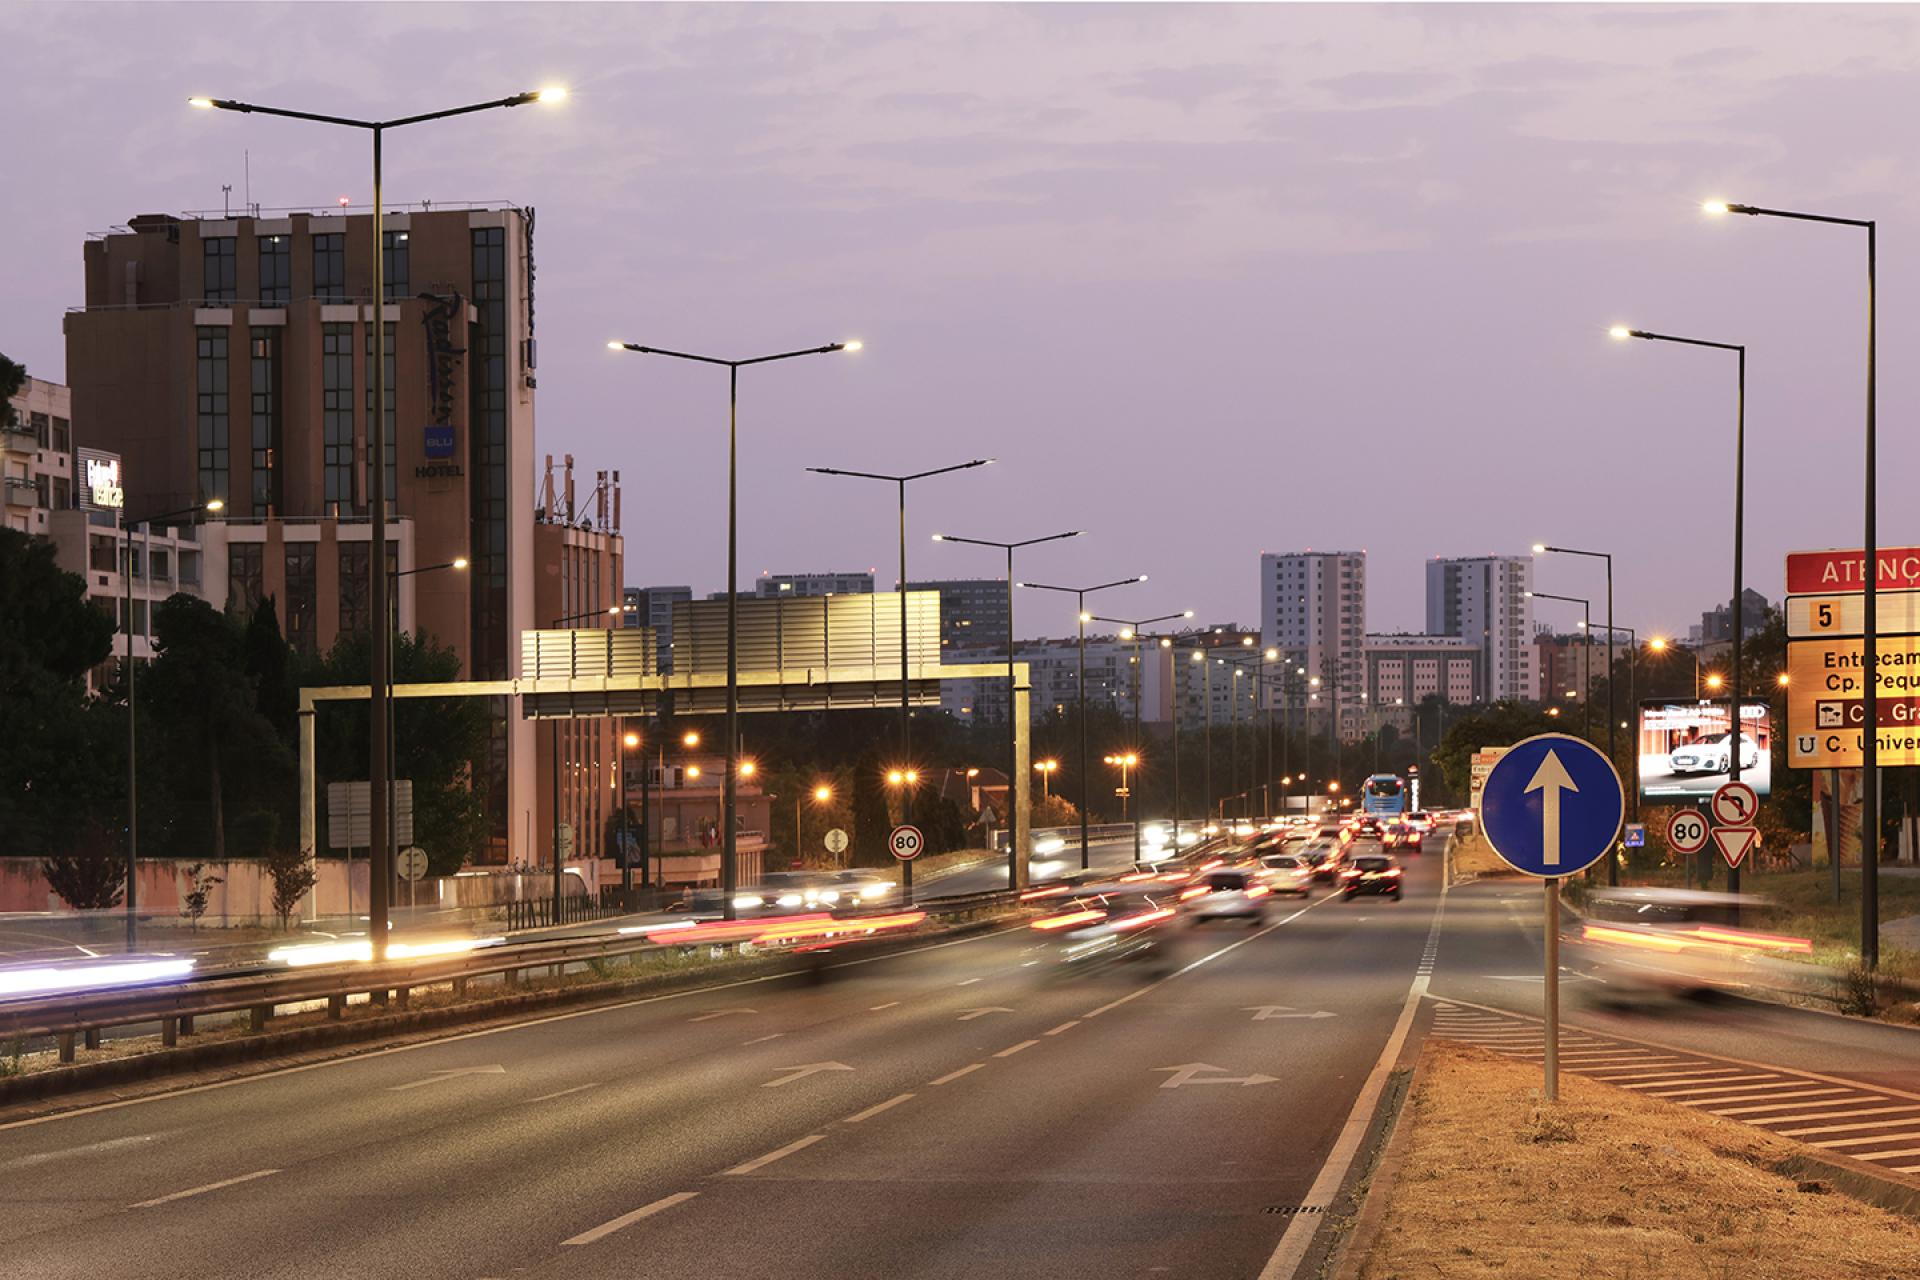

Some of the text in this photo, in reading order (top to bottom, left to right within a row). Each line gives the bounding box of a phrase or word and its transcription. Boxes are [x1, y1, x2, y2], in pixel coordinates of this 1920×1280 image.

[426, 437, 453, 447] BLU
[415, 466, 464, 478] HOTEL
[1819, 604, 1832, 628] 5
[1826, 674, 1860, 692] Cp.
[1849, 703, 1920, 722] C. Gr
[1826, 735, 1847, 752] C.
[1674, 823, 1701, 840] 80
[895, 836, 916, 849] 80
